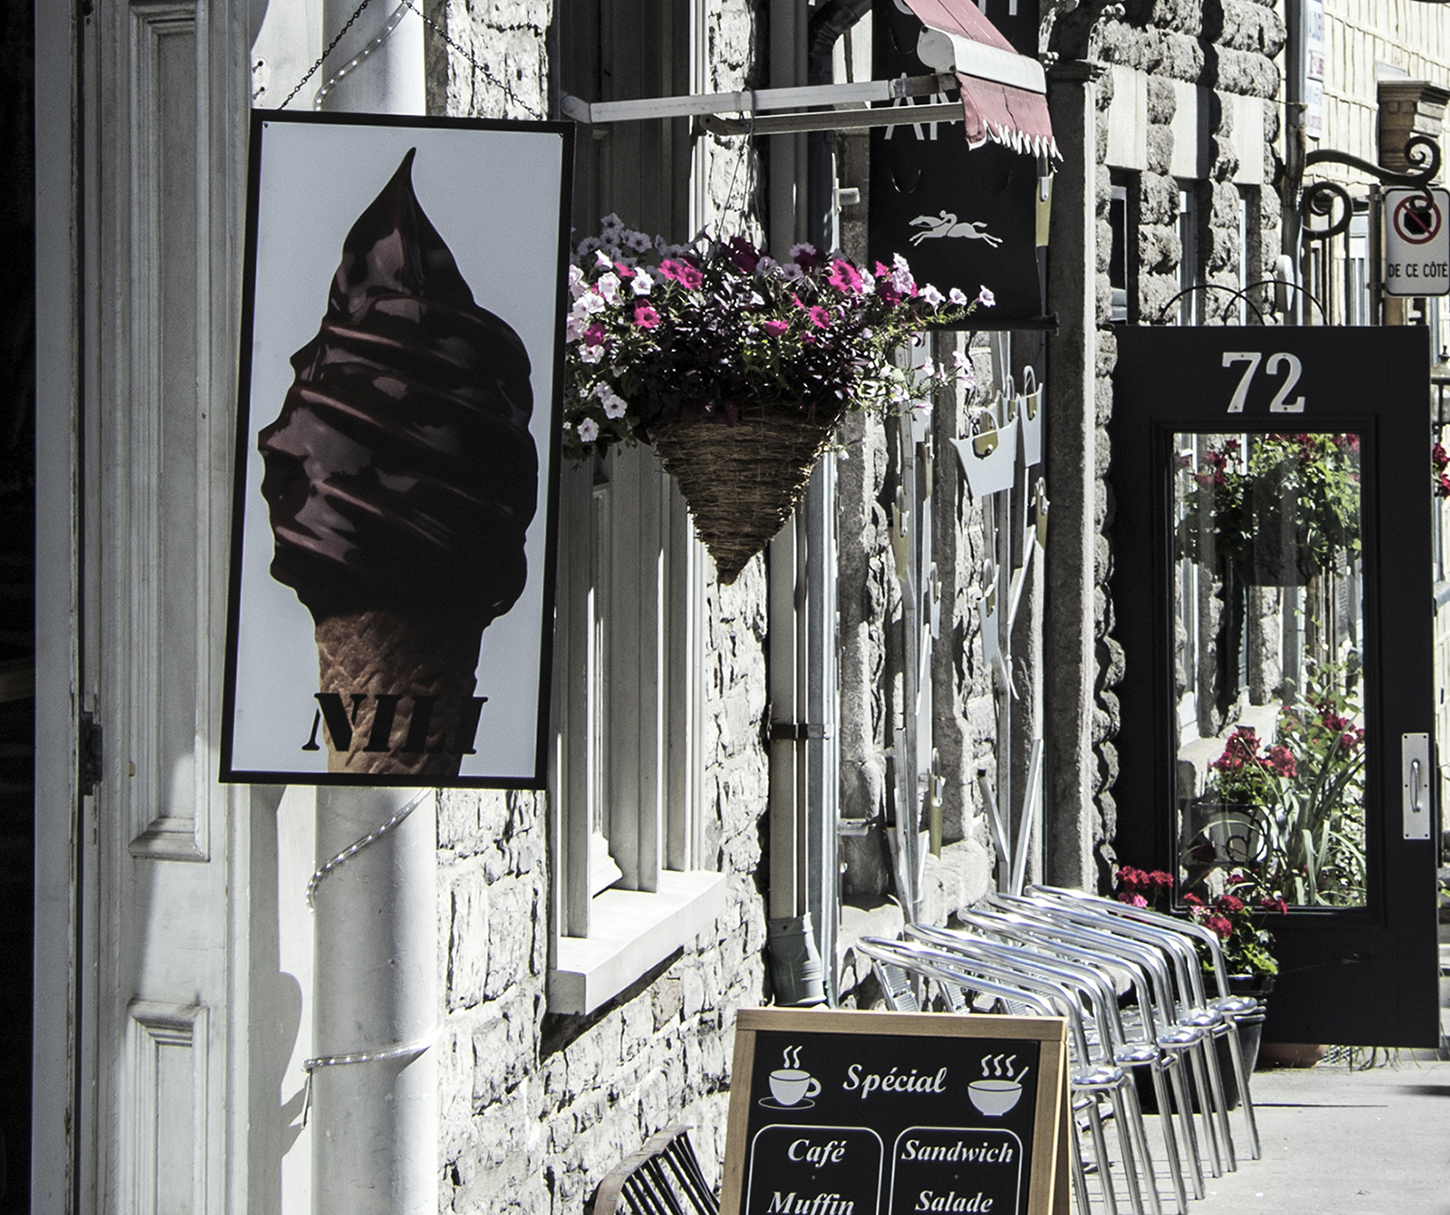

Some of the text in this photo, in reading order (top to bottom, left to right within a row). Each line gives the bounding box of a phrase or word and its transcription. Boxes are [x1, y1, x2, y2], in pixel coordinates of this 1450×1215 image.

[1388, 260, 1449, 278] DE CE CÔTÉ
[1221, 351, 1307, 415] 72
[842, 1063, 948, 1100] Spécial
[788, 1138, 847, 1168] Café
[901, 1139, 1014, 1163] Sandwich
[768, 1190, 855, 1215] Muffin
[914, 1189, 994, 1213] Salade
